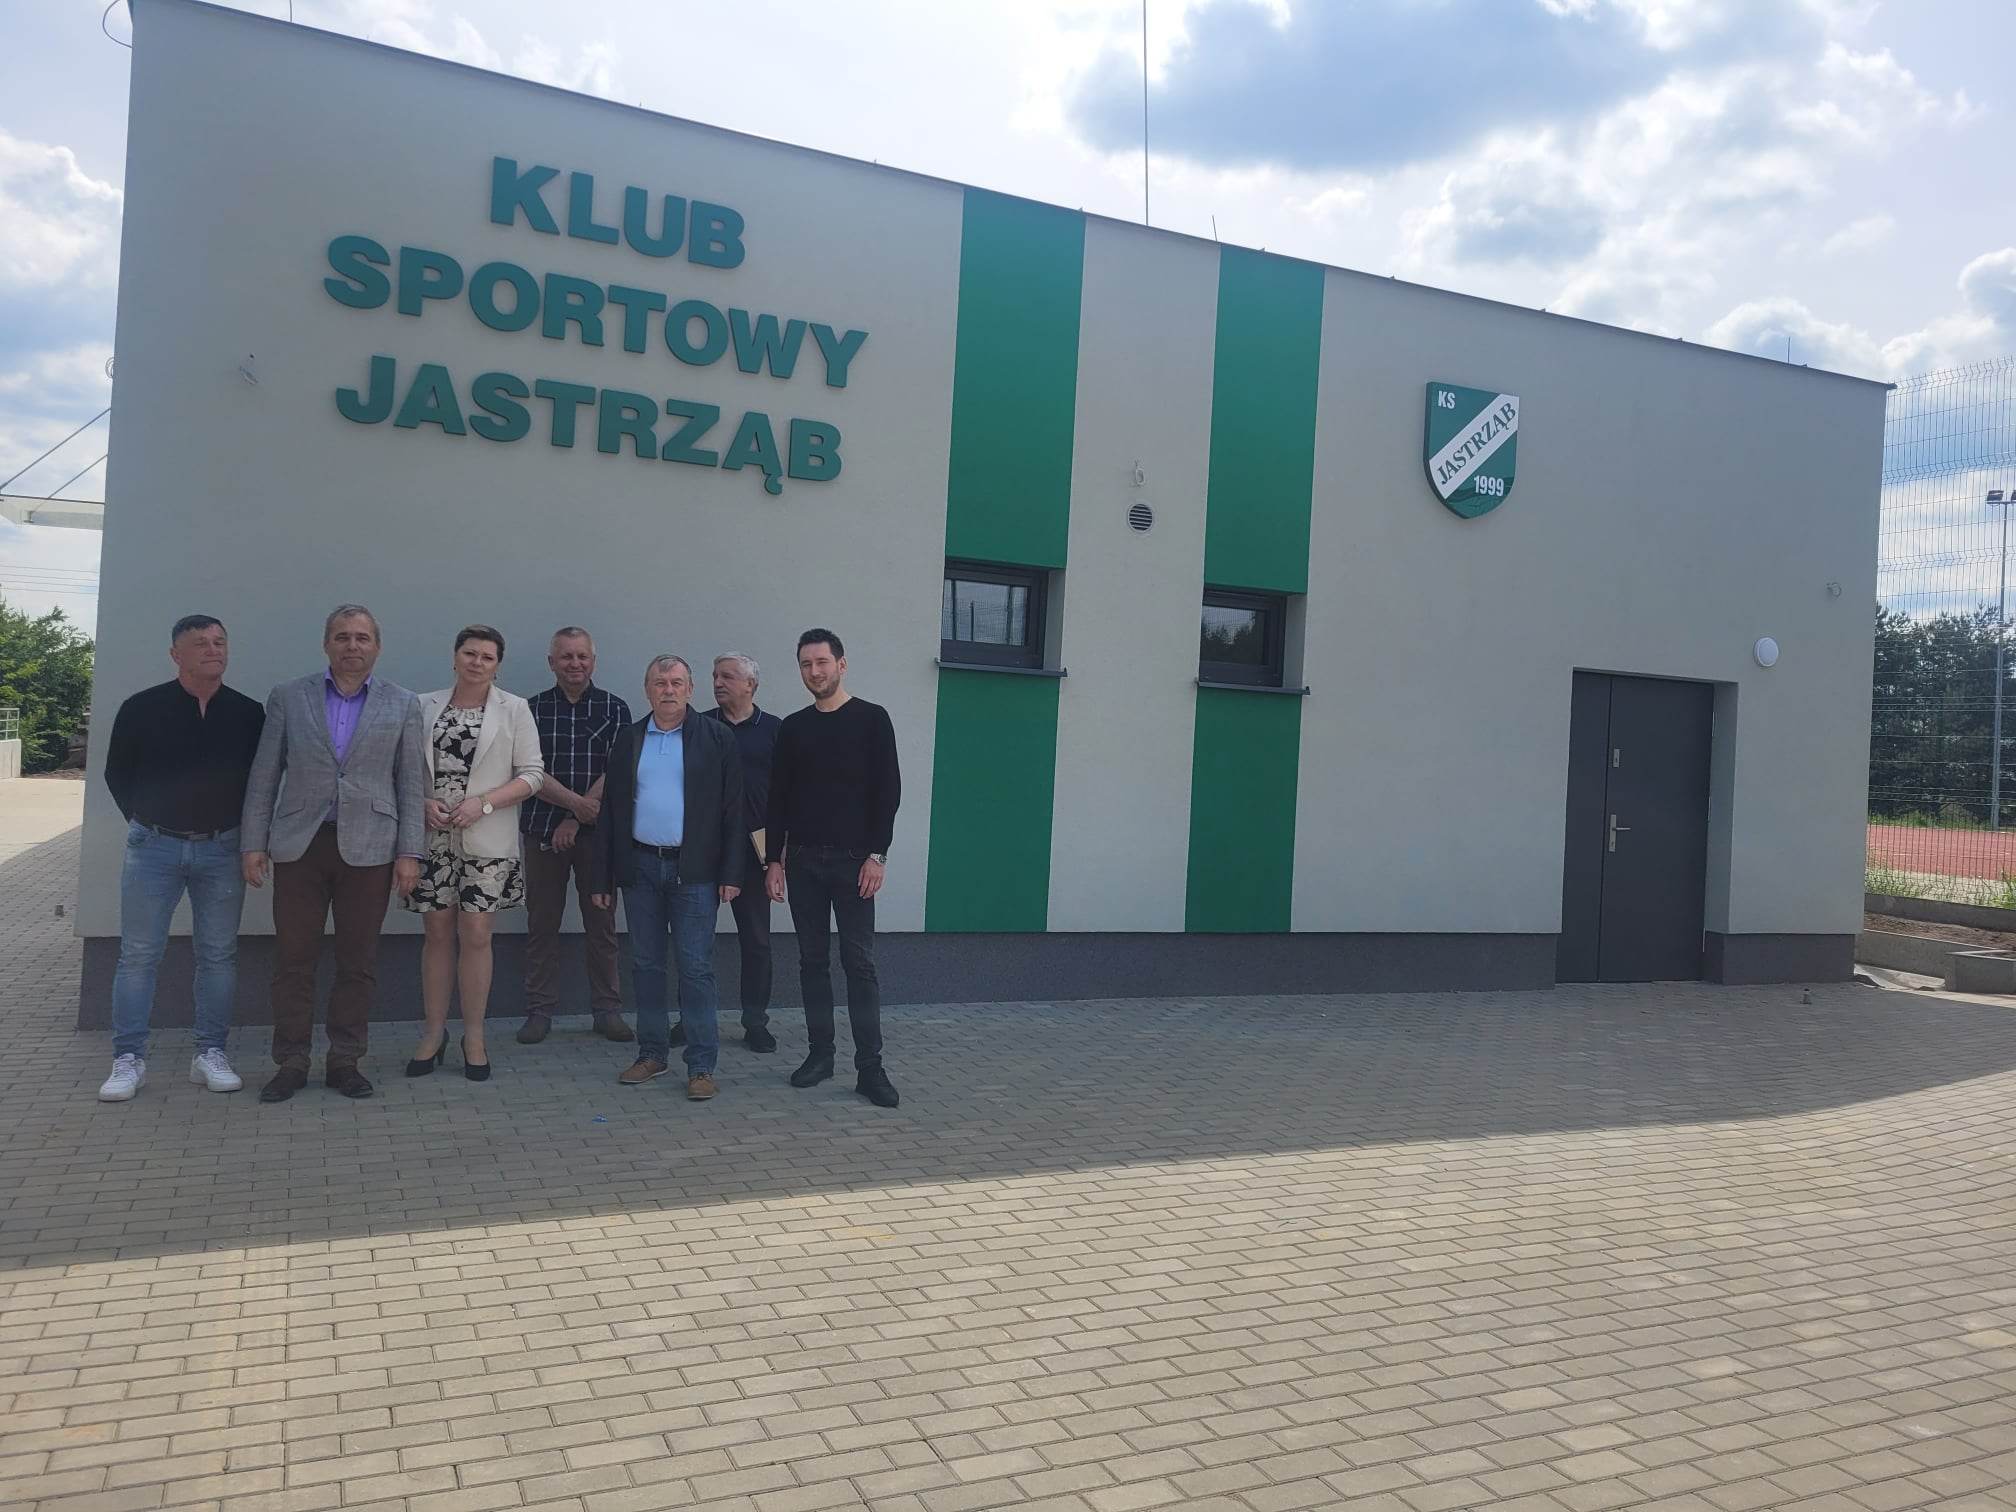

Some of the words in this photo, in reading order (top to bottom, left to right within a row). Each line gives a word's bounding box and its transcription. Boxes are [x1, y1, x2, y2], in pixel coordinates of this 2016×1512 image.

[490, 156, 746, 270] KLUB
[323, 234, 870, 388] SPORTOWY
[335, 355, 843, 495] JASTRZĄB
[1436, 402, 1516, 485] JASTRZĄB
[1437, 390, 1456, 409] KS
[1473, 475, 1505, 497] 1999
